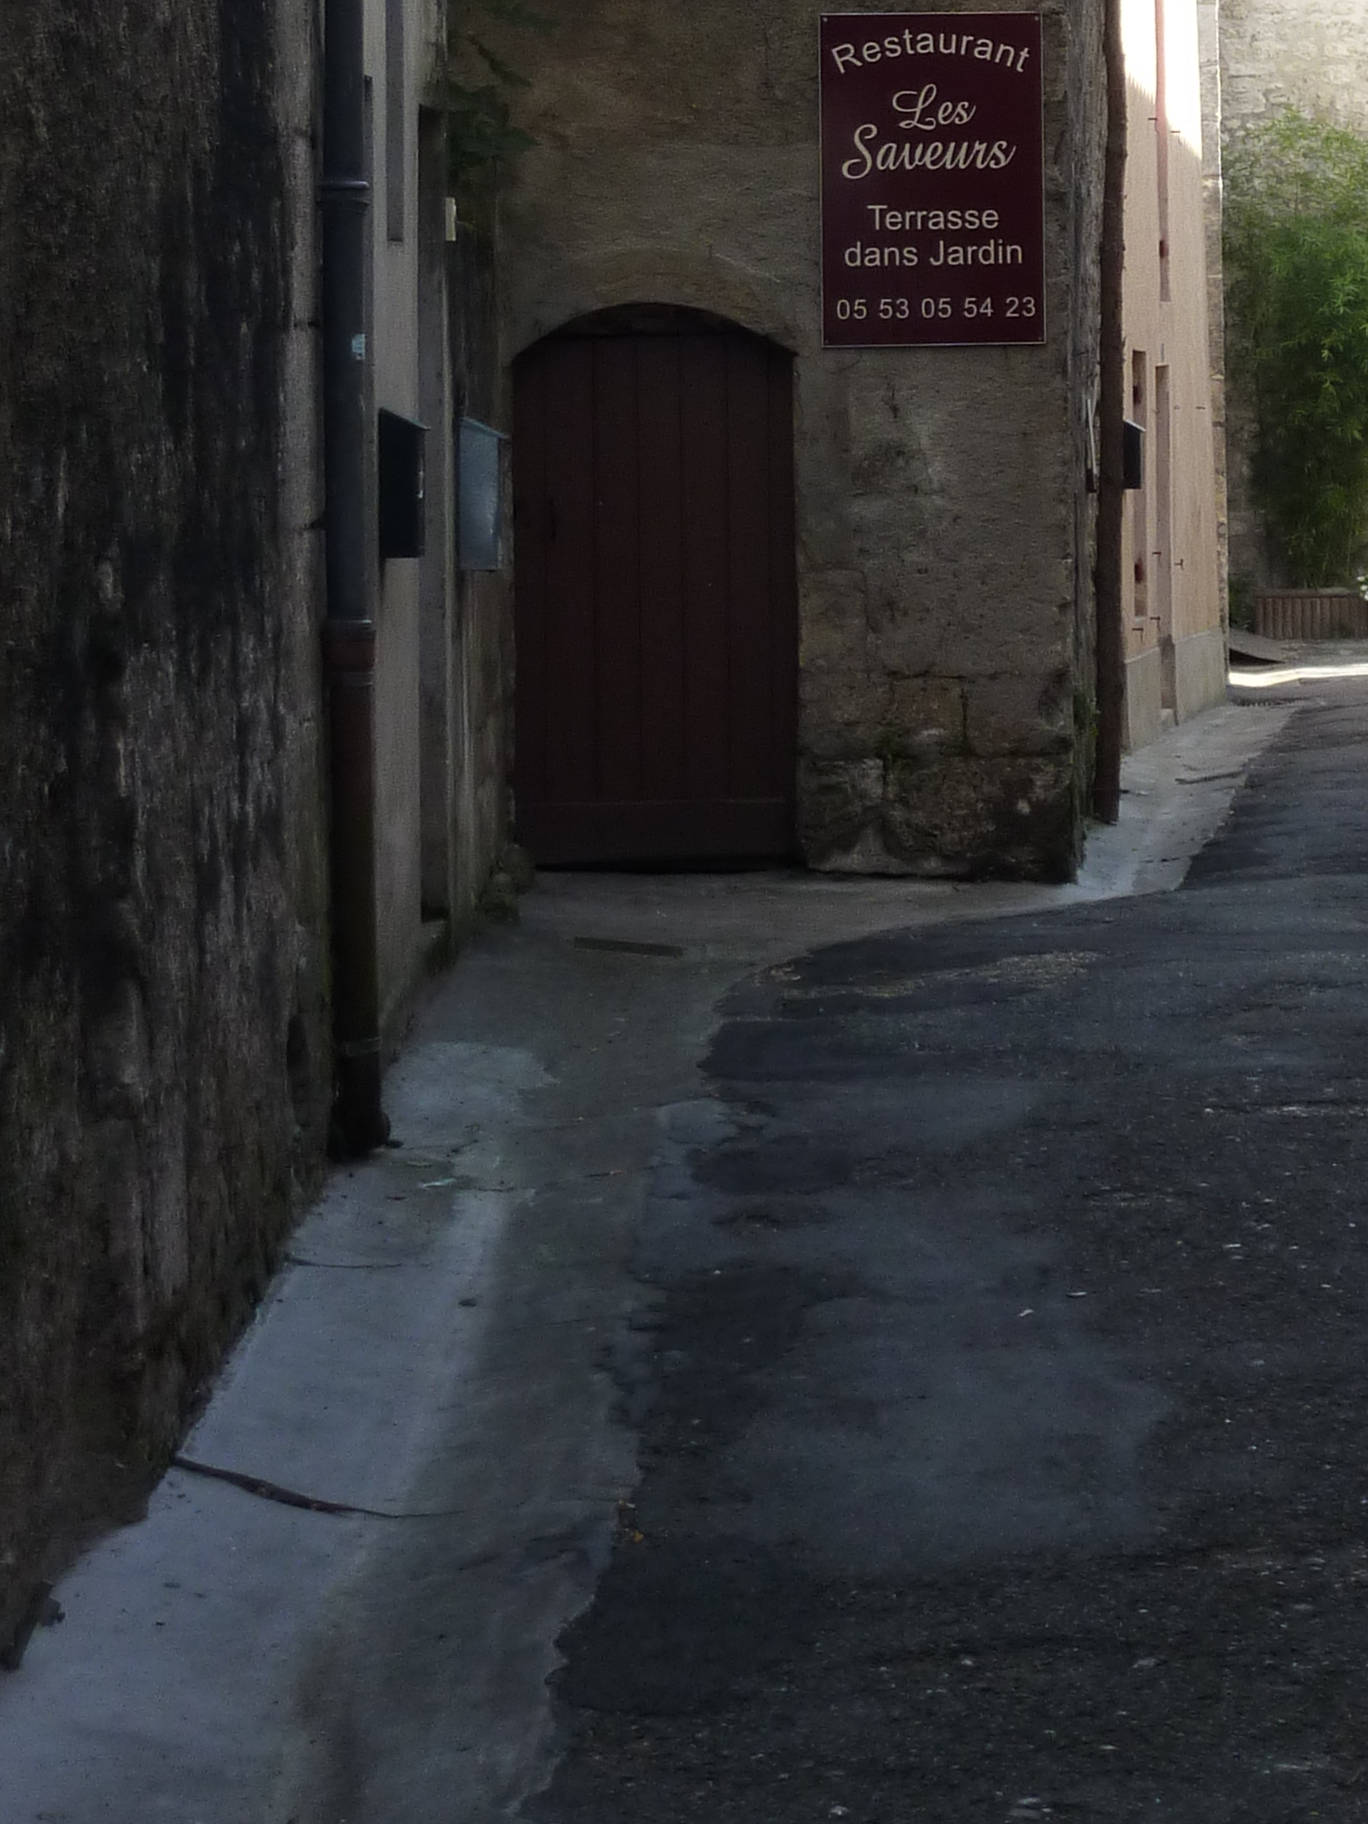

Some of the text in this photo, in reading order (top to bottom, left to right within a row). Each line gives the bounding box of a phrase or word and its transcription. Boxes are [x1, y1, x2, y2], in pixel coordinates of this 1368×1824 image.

[832, 29, 1030, 73] Restaurant
[892, 84, 976, 130] Les
[842, 124, 1016, 179] Saveurs
[867, 205, 999, 231] Terrasse
[845, 239, 1023, 267] dans Jardin
[837, 297, 1036, 319] 05 53 05 54 23
